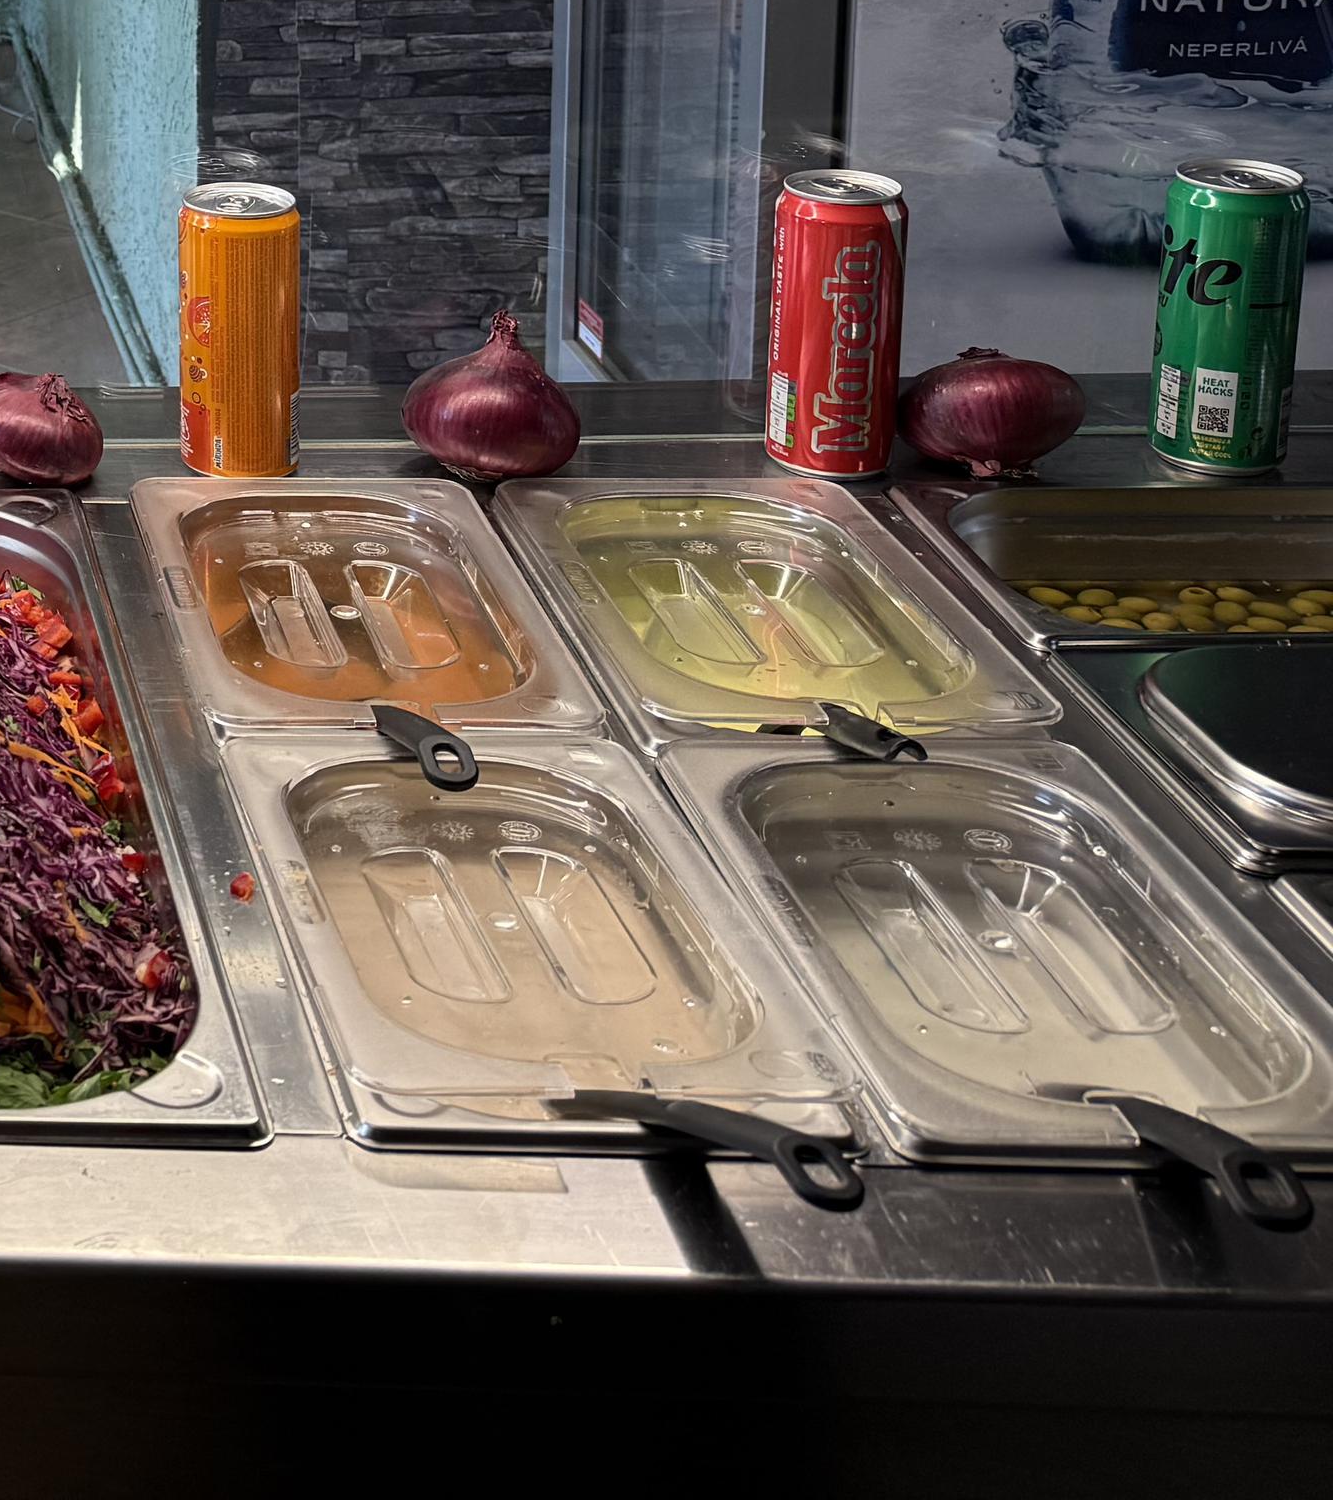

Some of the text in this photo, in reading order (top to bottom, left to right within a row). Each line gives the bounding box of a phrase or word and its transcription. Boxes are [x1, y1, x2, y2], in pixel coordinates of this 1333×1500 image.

[1168, 36, 1308, 58] NEPERLIVÁ
[775, 252, 784, 296] TASTE
[772, 299, 782, 361] ORIGINAL
[811, 240, 883, 453] Marcela
[1197, 385, 1234, 398] HACKS
[1202, 376, 1230, 389] HEAT
